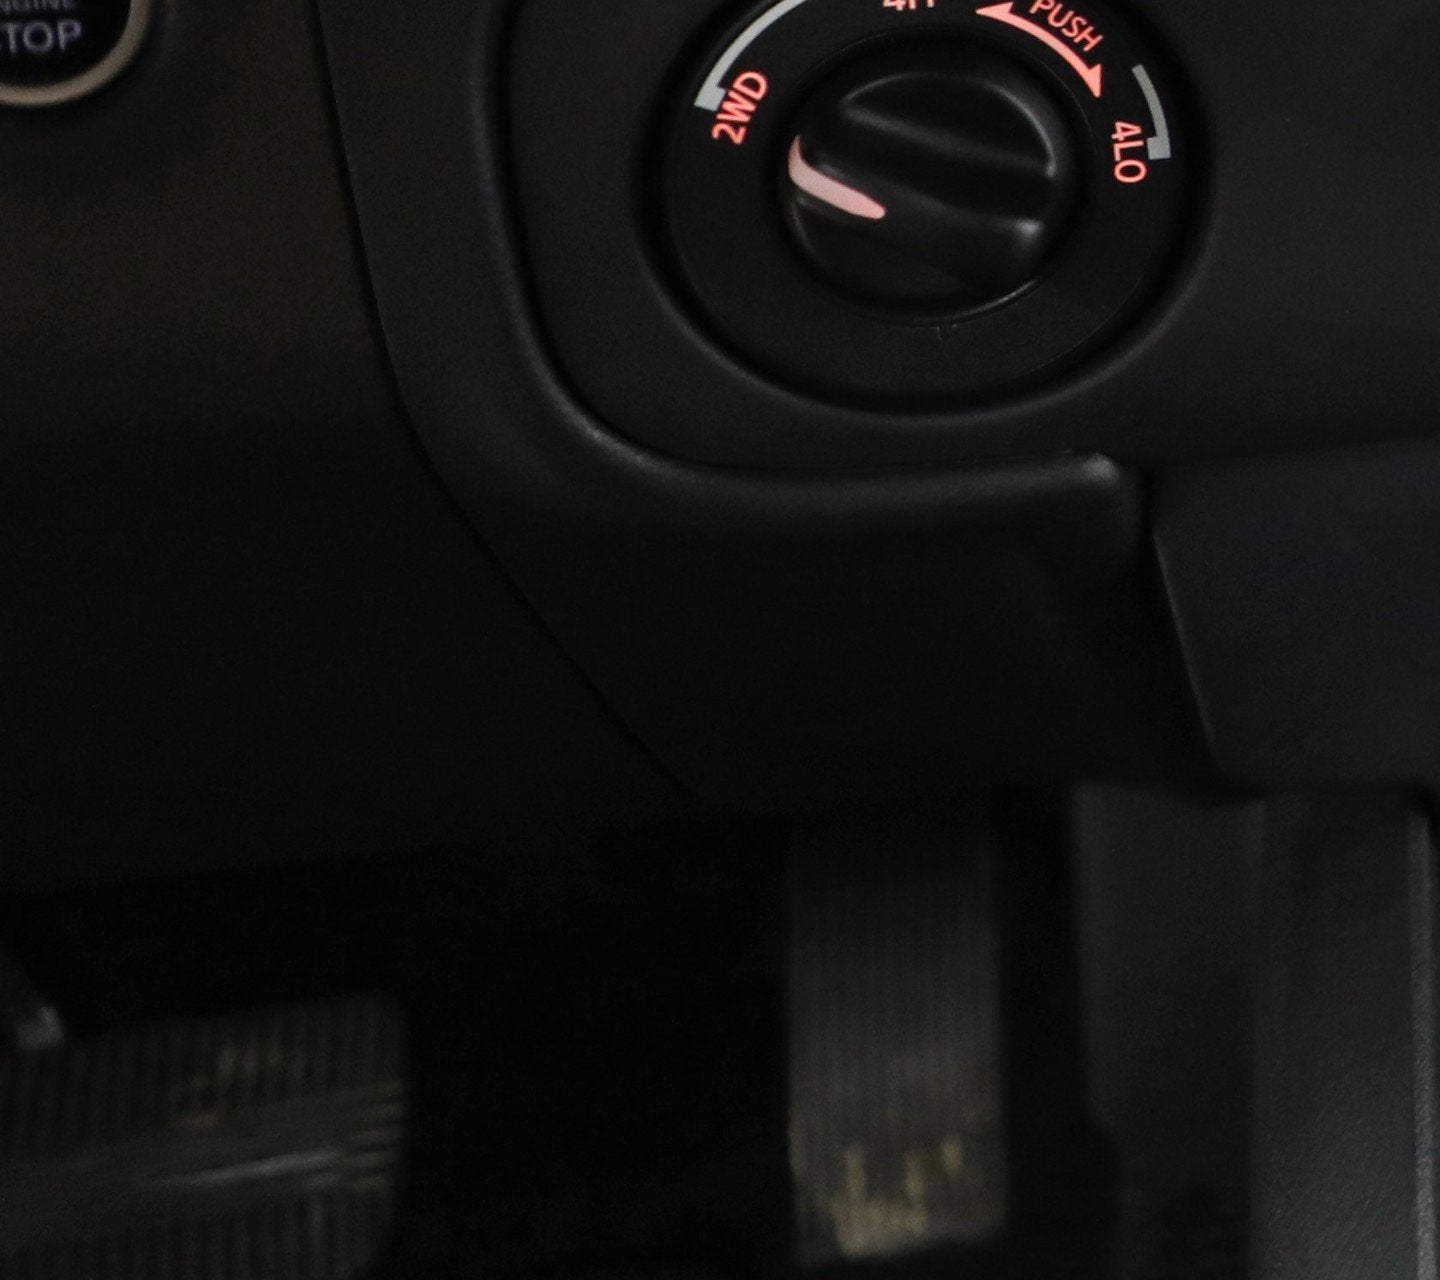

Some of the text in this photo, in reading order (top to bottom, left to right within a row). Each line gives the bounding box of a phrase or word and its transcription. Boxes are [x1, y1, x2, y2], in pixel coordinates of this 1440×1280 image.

[0, 17, 83, 57] TOP
[712, 69, 769, 145] 2WD
[1111, 120, 1147, 184] 4LO
